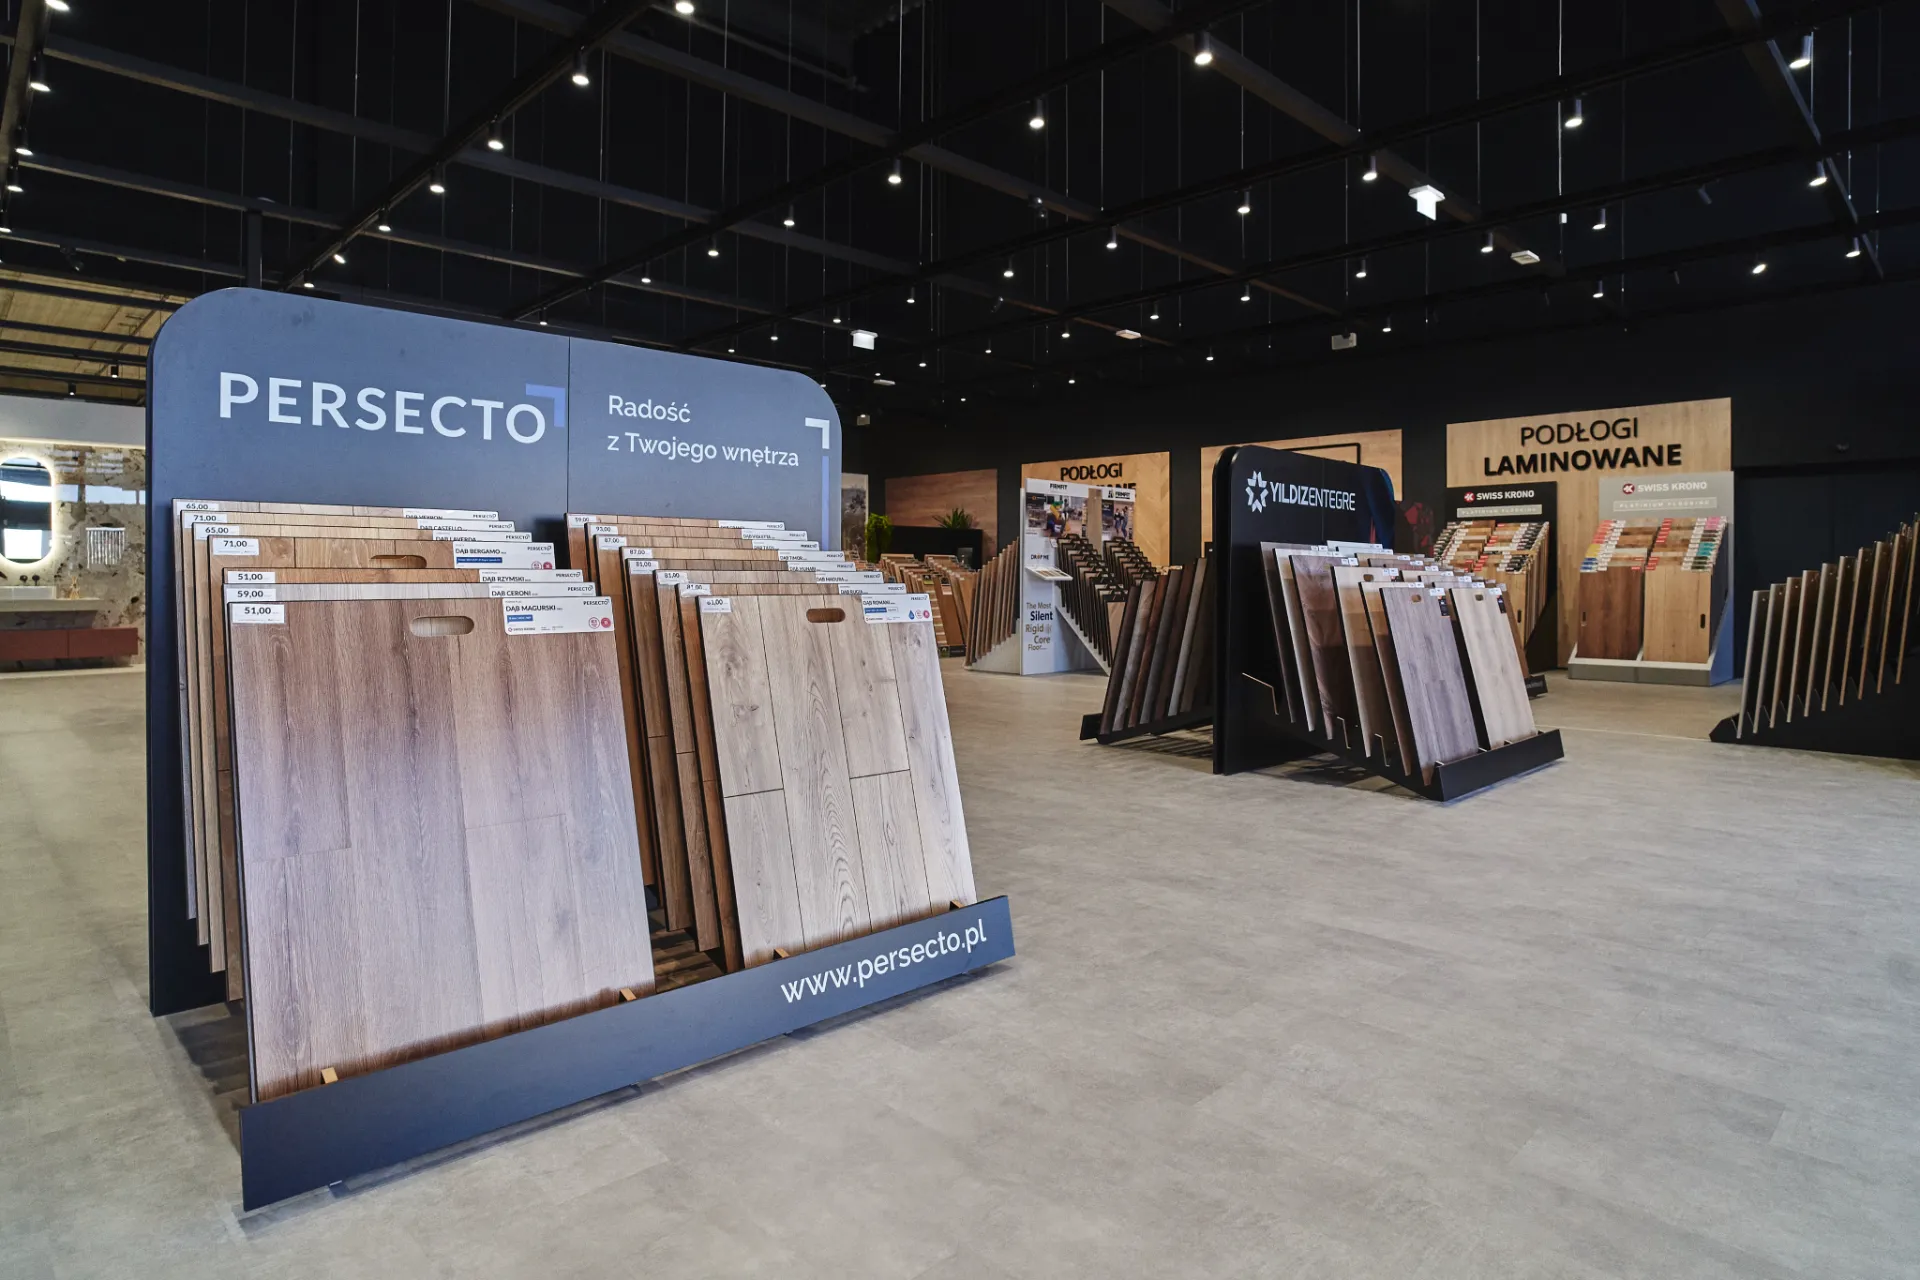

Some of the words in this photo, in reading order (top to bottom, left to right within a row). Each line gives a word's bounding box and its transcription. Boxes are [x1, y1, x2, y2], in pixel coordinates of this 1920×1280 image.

[220, 371, 546, 444] PERSECTO
[608, 394, 692, 423] Radość
[1520, 417, 1638, 447] PODŁOGI
[607, 434, 619, 451] z
[625, 431, 717, 464] Twojego
[722, 445, 800, 467] wnętrza
[1484, 443, 1682, 477] LAMINOWANE
[1060, 462, 1122, 481] PODŁOGI
[1269, 481, 1356, 511] YILDIZENTEGRE
[1476, 492, 1503, 500] SWISS
[1504, 490, 1534, 499] KRONO
[1637, 484, 1669, 492] SWISS
[1671, 482, 1708, 490] KRONO
[238, 590, 264, 598] 59,00
[244, 607, 271, 615] 51,00
[1030, 611, 1053, 621] Silent
[1025, 624, 1044, 634] Rigid
[1034, 635, 1050, 644] Core
[780, 918, 987, 1004] www.persecto.pl
